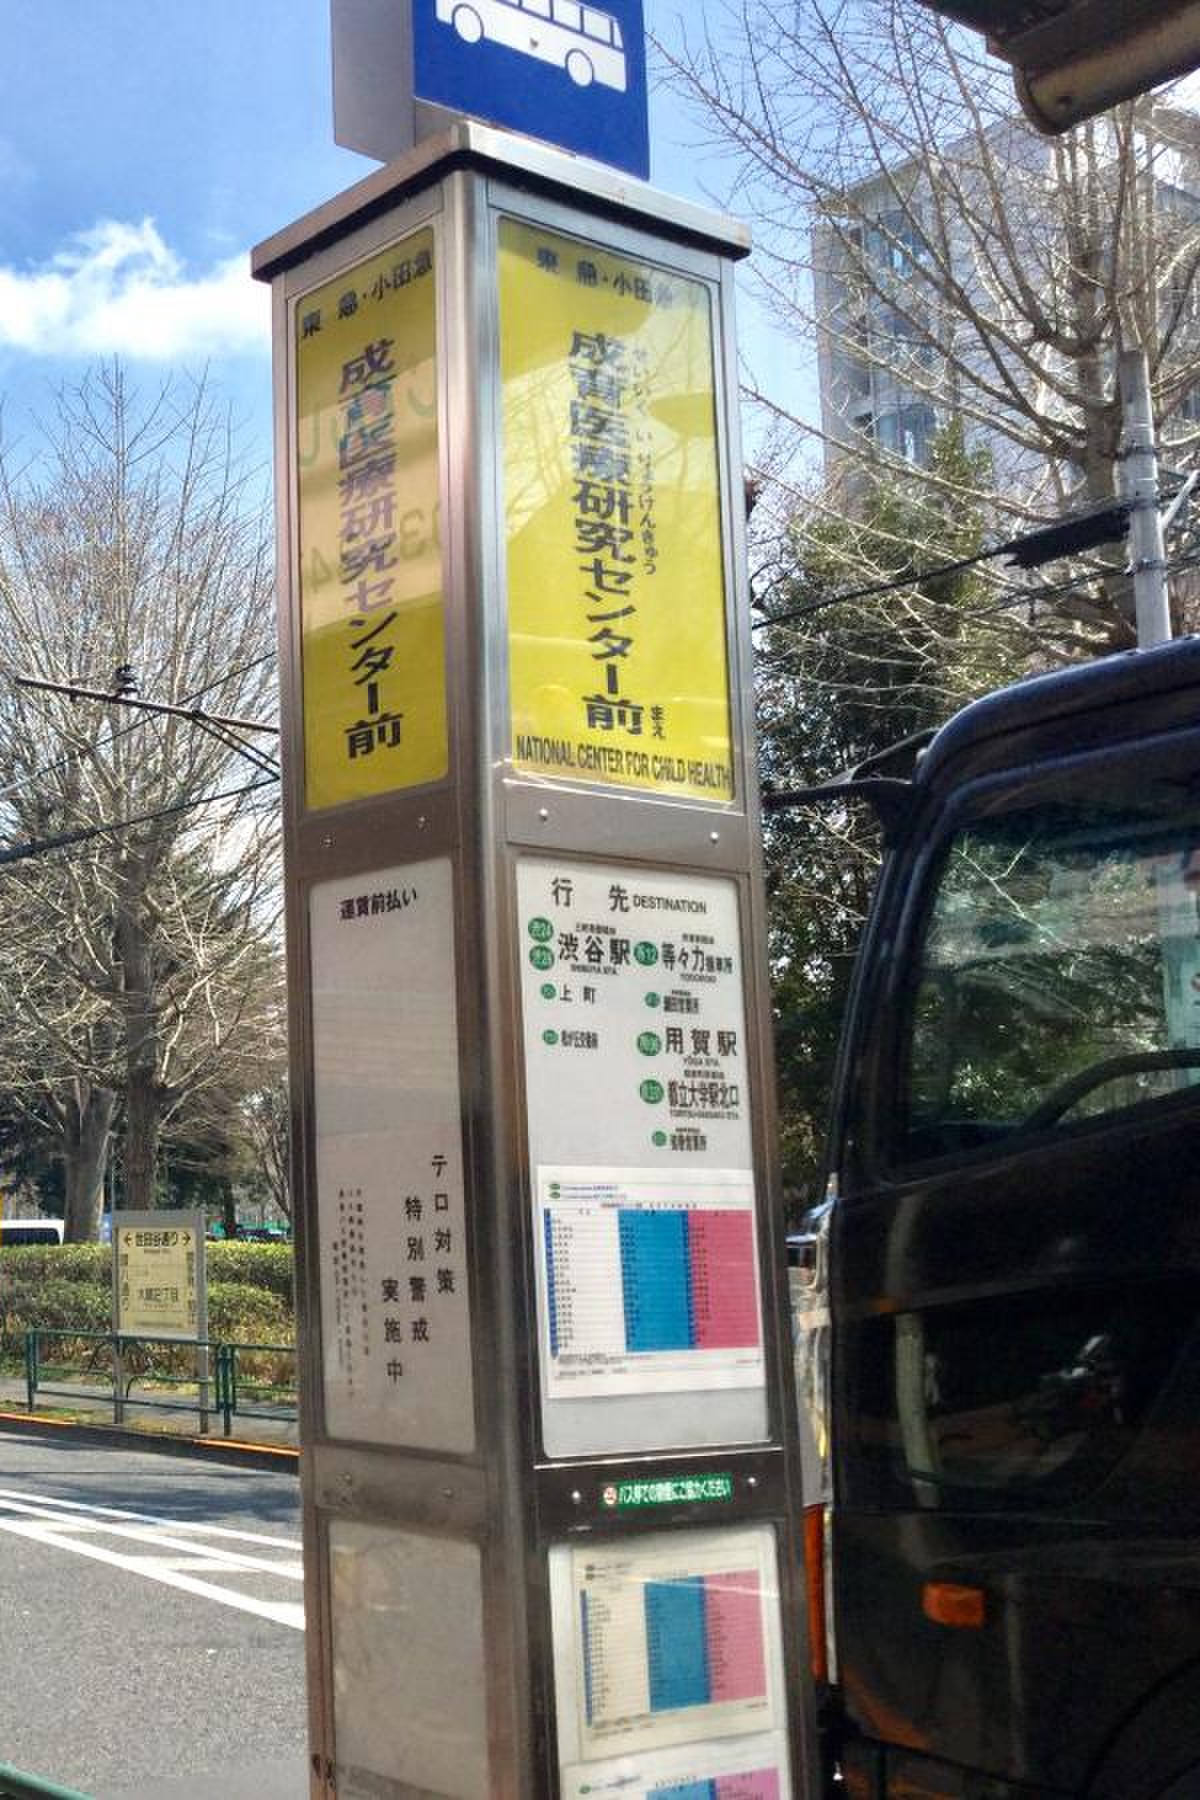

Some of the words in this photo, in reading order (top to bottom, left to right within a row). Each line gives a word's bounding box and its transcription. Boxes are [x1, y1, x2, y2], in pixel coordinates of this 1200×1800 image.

[338, 338, 405, 760] 成育医療研究センター前
[568, 329, 645, 738] 成育医療研究センター前
[516, 735, 576, 767] NATIONAL
[577, 744, 624, 774] CENTER
[625, 751, 650, 778] FOR
[651, 755, 687, 783] CHILD
[687, 759, 733, 790] HEALTH
[340, 887, 417, 920] 運賃前払い
[632, 893, 707, 915] DESTINATION
[558, 933, 631, 966] 渋谷駅
[559, 983, 596, 1004] 上町
[665, 1027, 737, 1057] 用賀駅
[667, 1080, 739, 1109] 都立大学駅北口
[431, 1154, 456, 1295] テロ対策
[404, 1196, 430, 1343] 特別警戒
[381, 1278, 404, 1384] 実施中
